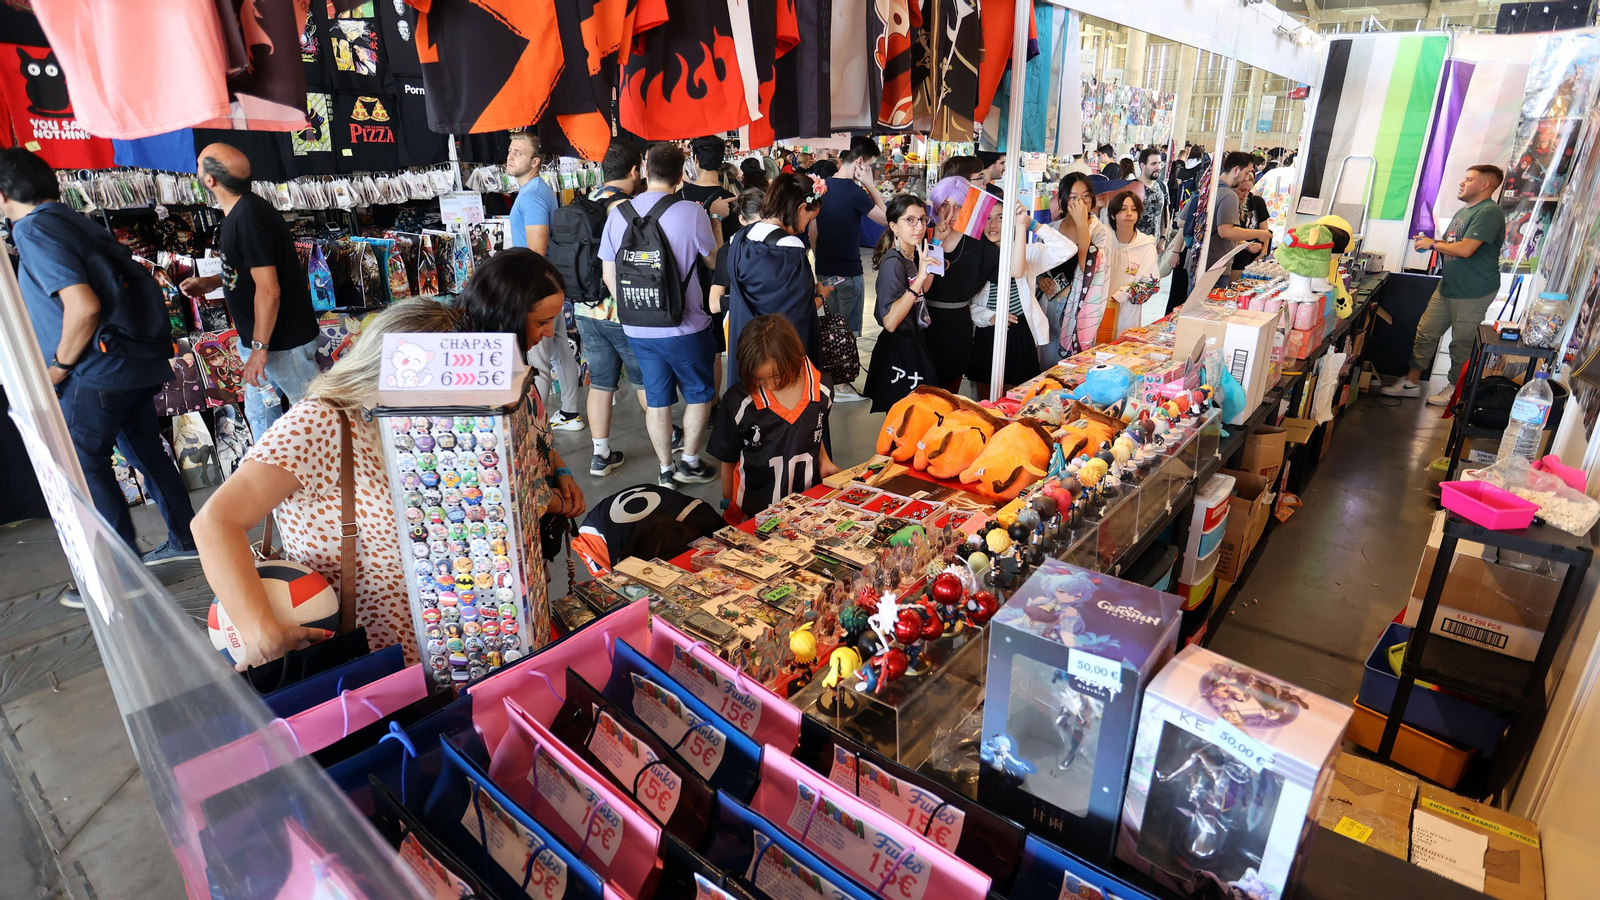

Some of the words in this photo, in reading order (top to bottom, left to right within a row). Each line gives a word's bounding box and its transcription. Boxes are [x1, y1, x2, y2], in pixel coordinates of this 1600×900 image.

[404, 84, 425, 95] Porn
[29, 118, 60, 130] YOU
[61, 120, 81, 131] SA
[33, 129, 91, 140] NOTHING
[348, 123, 396, 144] PIZZA
[440, 338, 503, 350] CHAPAS
[443, 352, 450, 366] 1
[440, 370, 453, 387] 6
[891, 365, 924, 390] アナ
[768, 452, 814, 504] 10
[1097, 600, 1162, 627] GENSHIN
[1076, 660, 1108, 677] 50,00
[1110, 670, 1119, 680] €
[723, 679, 758, 711] Funko
[719, 696, 754, 730] 15€
[683, 732, 717, 767] 15€
[1219, 731, 1254, 758] 50,00
[1255, 756, 1266, 766] €
[834, 763, 872, 789] CONTINE:
[636, 770, 672, 812] 15€
[799, 800, 837, 828] CONIENE:
[908, 788, 956, 826] Funko
[1429, 802, 1459, 816] ENTREGA
[1460, 813, 1470, 821] EN
[1471, 817, 1500, 831] SABADO
[581, 806, 616, 850] 15€
[905, 806, 952, 849] 15€
[520, 852, 559, 899] 15€
[869, 852, 918, 899] 15€
